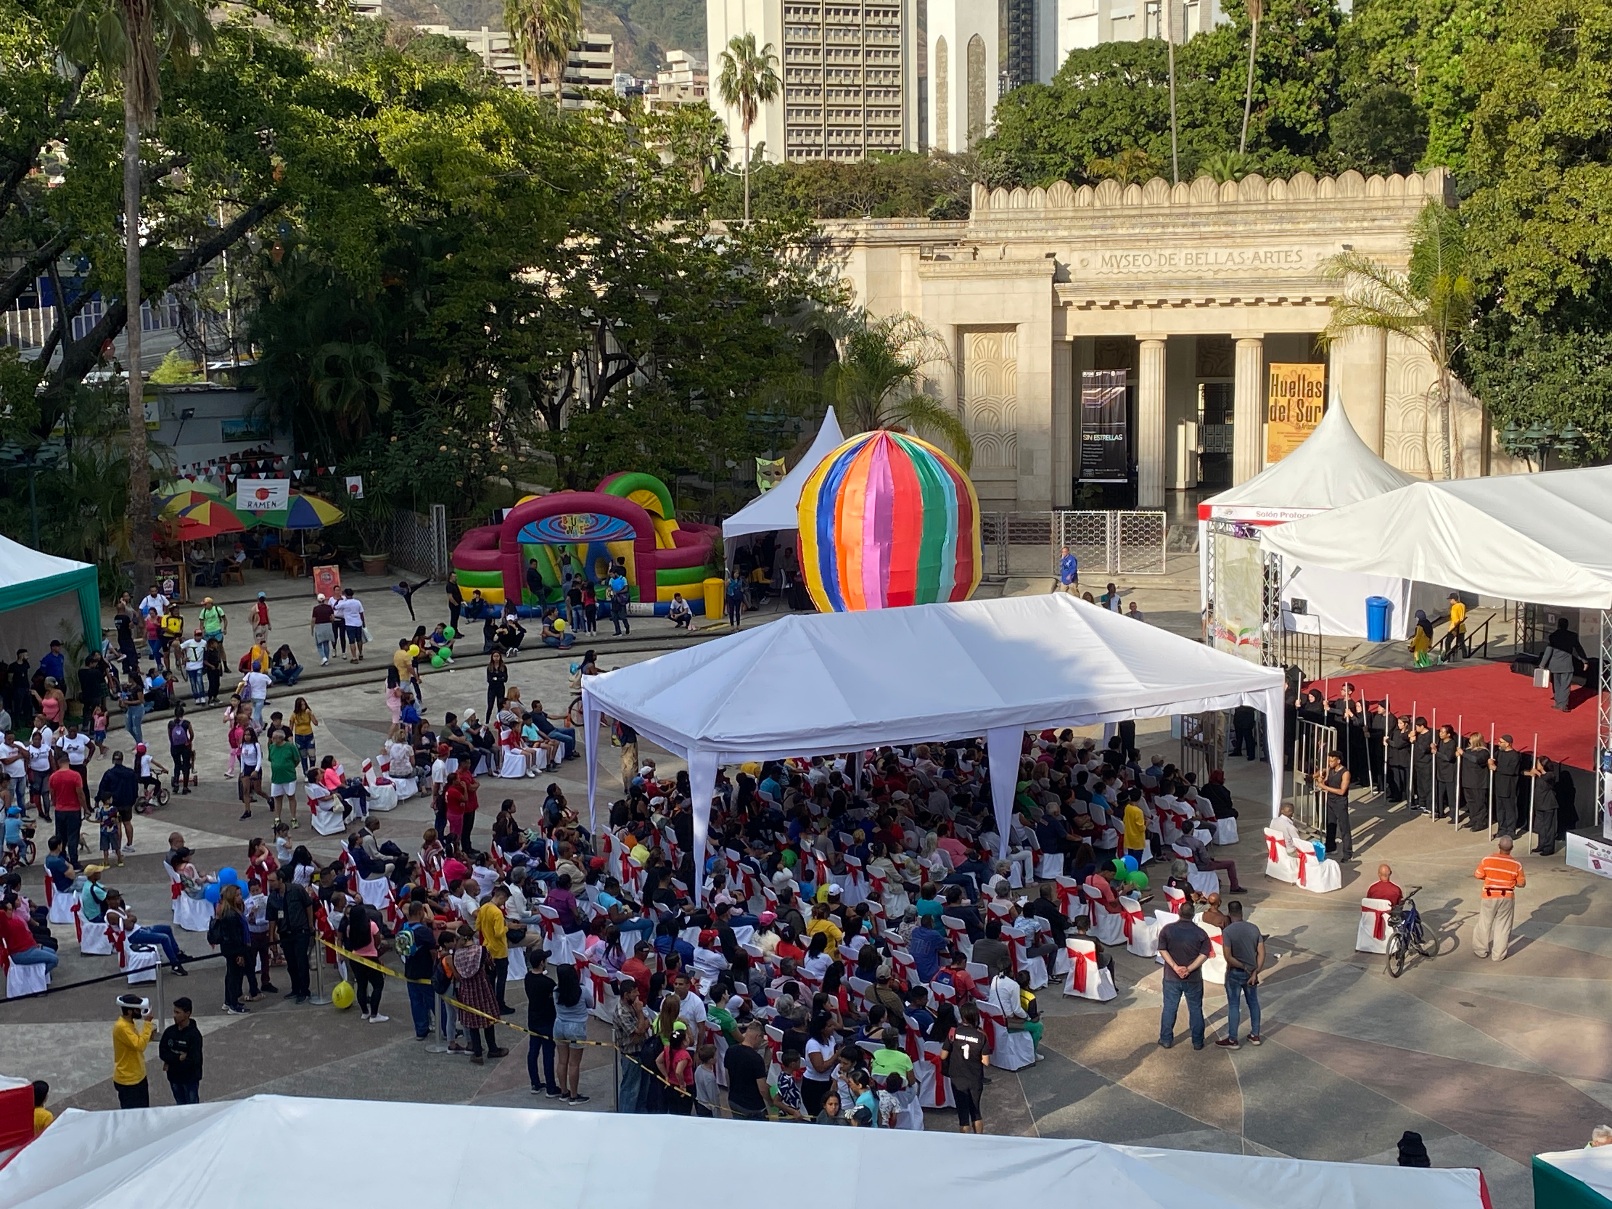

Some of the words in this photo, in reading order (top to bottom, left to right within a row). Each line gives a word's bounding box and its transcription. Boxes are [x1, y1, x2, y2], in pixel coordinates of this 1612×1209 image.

[1158, 253, 1177, 267] DE
[1184, 252, 1246, 266] BELLAS
[1251, 250, 1303, 264] ARTES
[1271, 373, 1322, 398] Huellas
[1269, 398, 1291, 423] del
[1296, 398, 1322, 423] Sur
[1082, 433, 1093, 441] SIN
[1093, 433, 1123, 441] ESTRELLAS
[247, 500, 277, 509] RAMEN
[1256, 510, 1278, 519] Salón
[961, 1043, 970, 1060] 1
